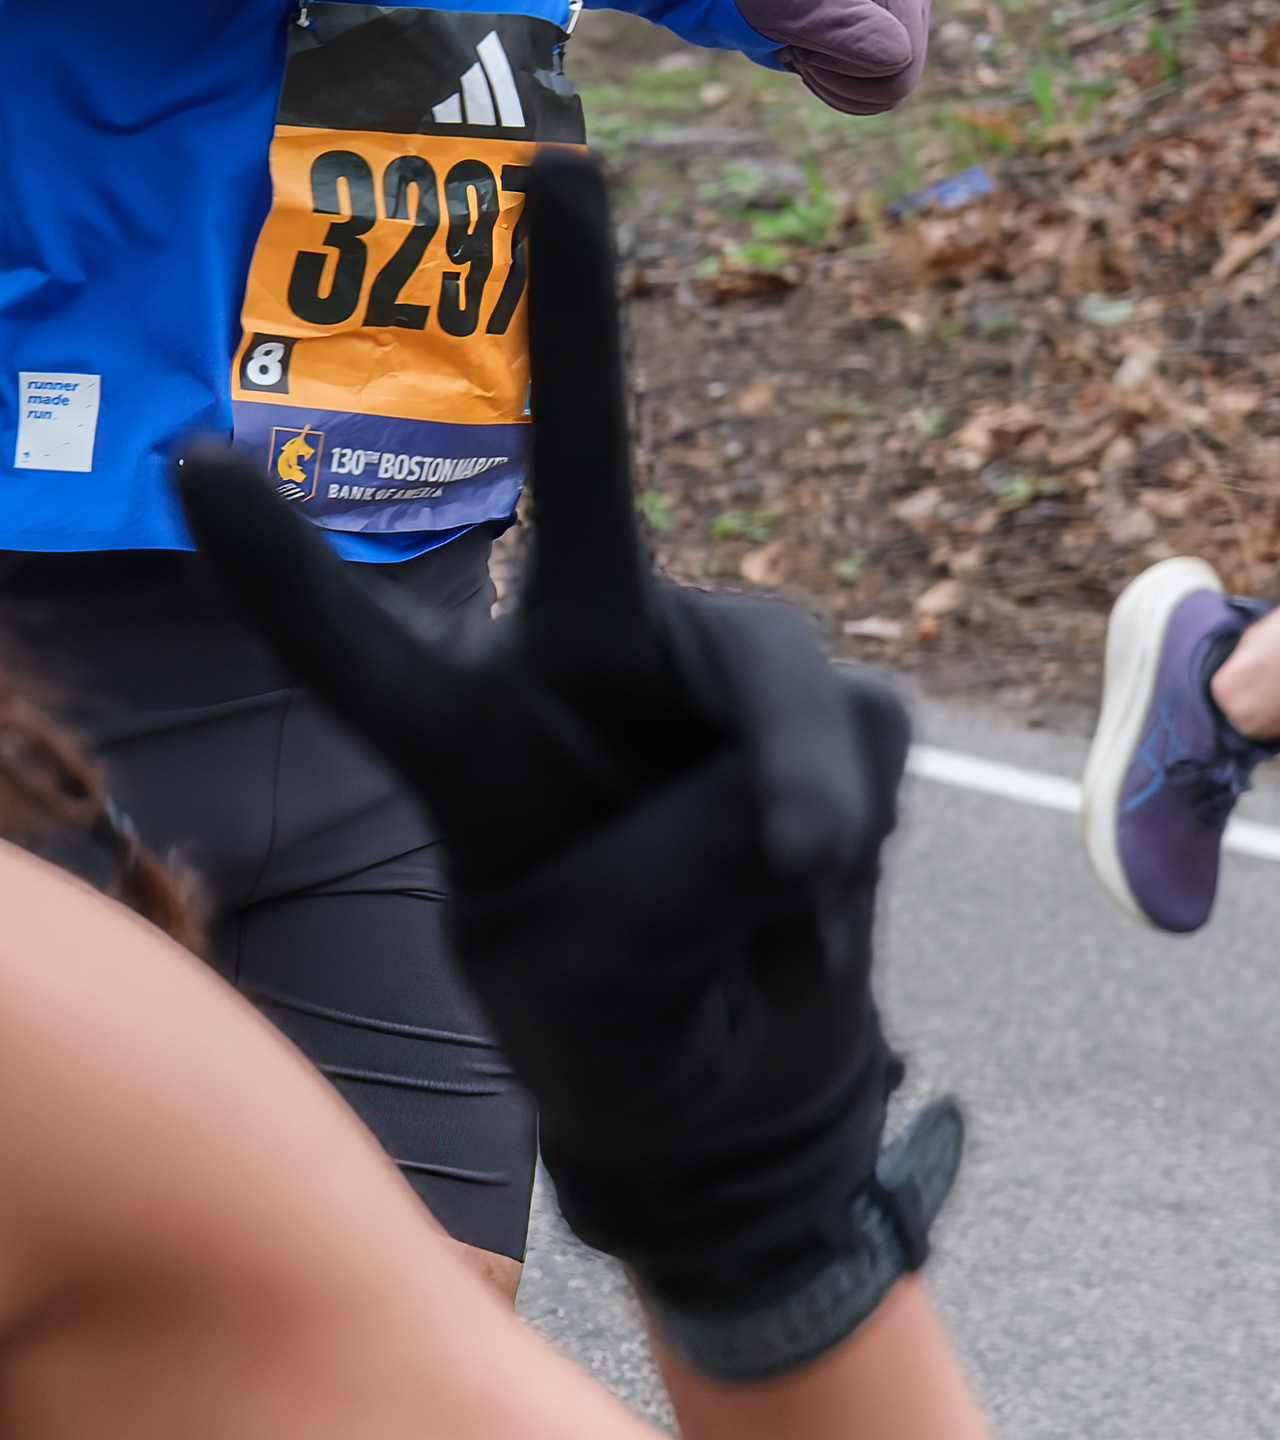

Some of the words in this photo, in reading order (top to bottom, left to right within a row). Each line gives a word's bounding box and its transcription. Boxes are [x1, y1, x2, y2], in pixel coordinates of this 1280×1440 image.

[245, 340, 285, 387] 8
[26, 380, 80, 392] runner
[27, 393, 71, 406] made
[26, 409, 53, 420] run
[377, 452, 458, 483] BOSTON
[327, 483, 377, 500] BANK
[374, 488, 398, 501] OF
